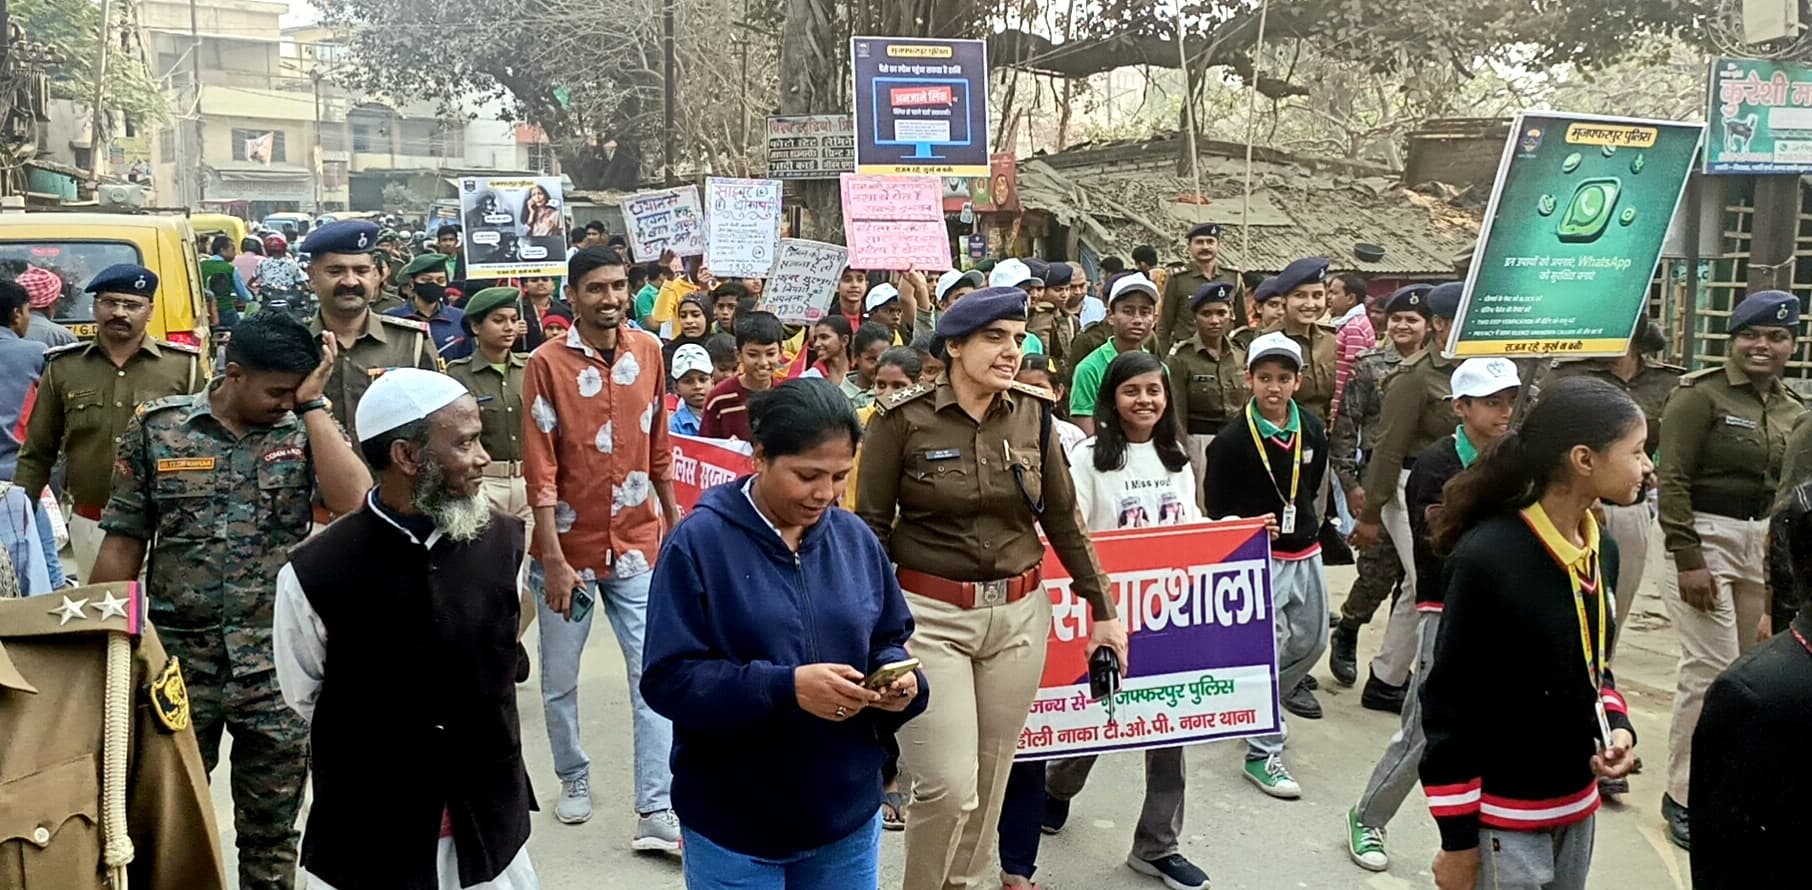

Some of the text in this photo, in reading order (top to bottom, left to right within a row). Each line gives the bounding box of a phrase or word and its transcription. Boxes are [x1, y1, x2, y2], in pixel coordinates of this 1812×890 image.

[1625, 128, 1653, 144] पुलिस
[1577, 255, 1632, 271] WhatsApp
[672, 446, 698, 486] लिस
[1131, 479, 1152, 490] Miss
[1029, 697, 1068, 714] जन्य
[1188, 674, 1235, 706] पुलिस
[1016, 725, 1054, 750] हौली
[1057, 724, 1099, 744] नाका
[1179, 712, 1216, 731] नगर
[1219, 708, 1256, 727] थाना
